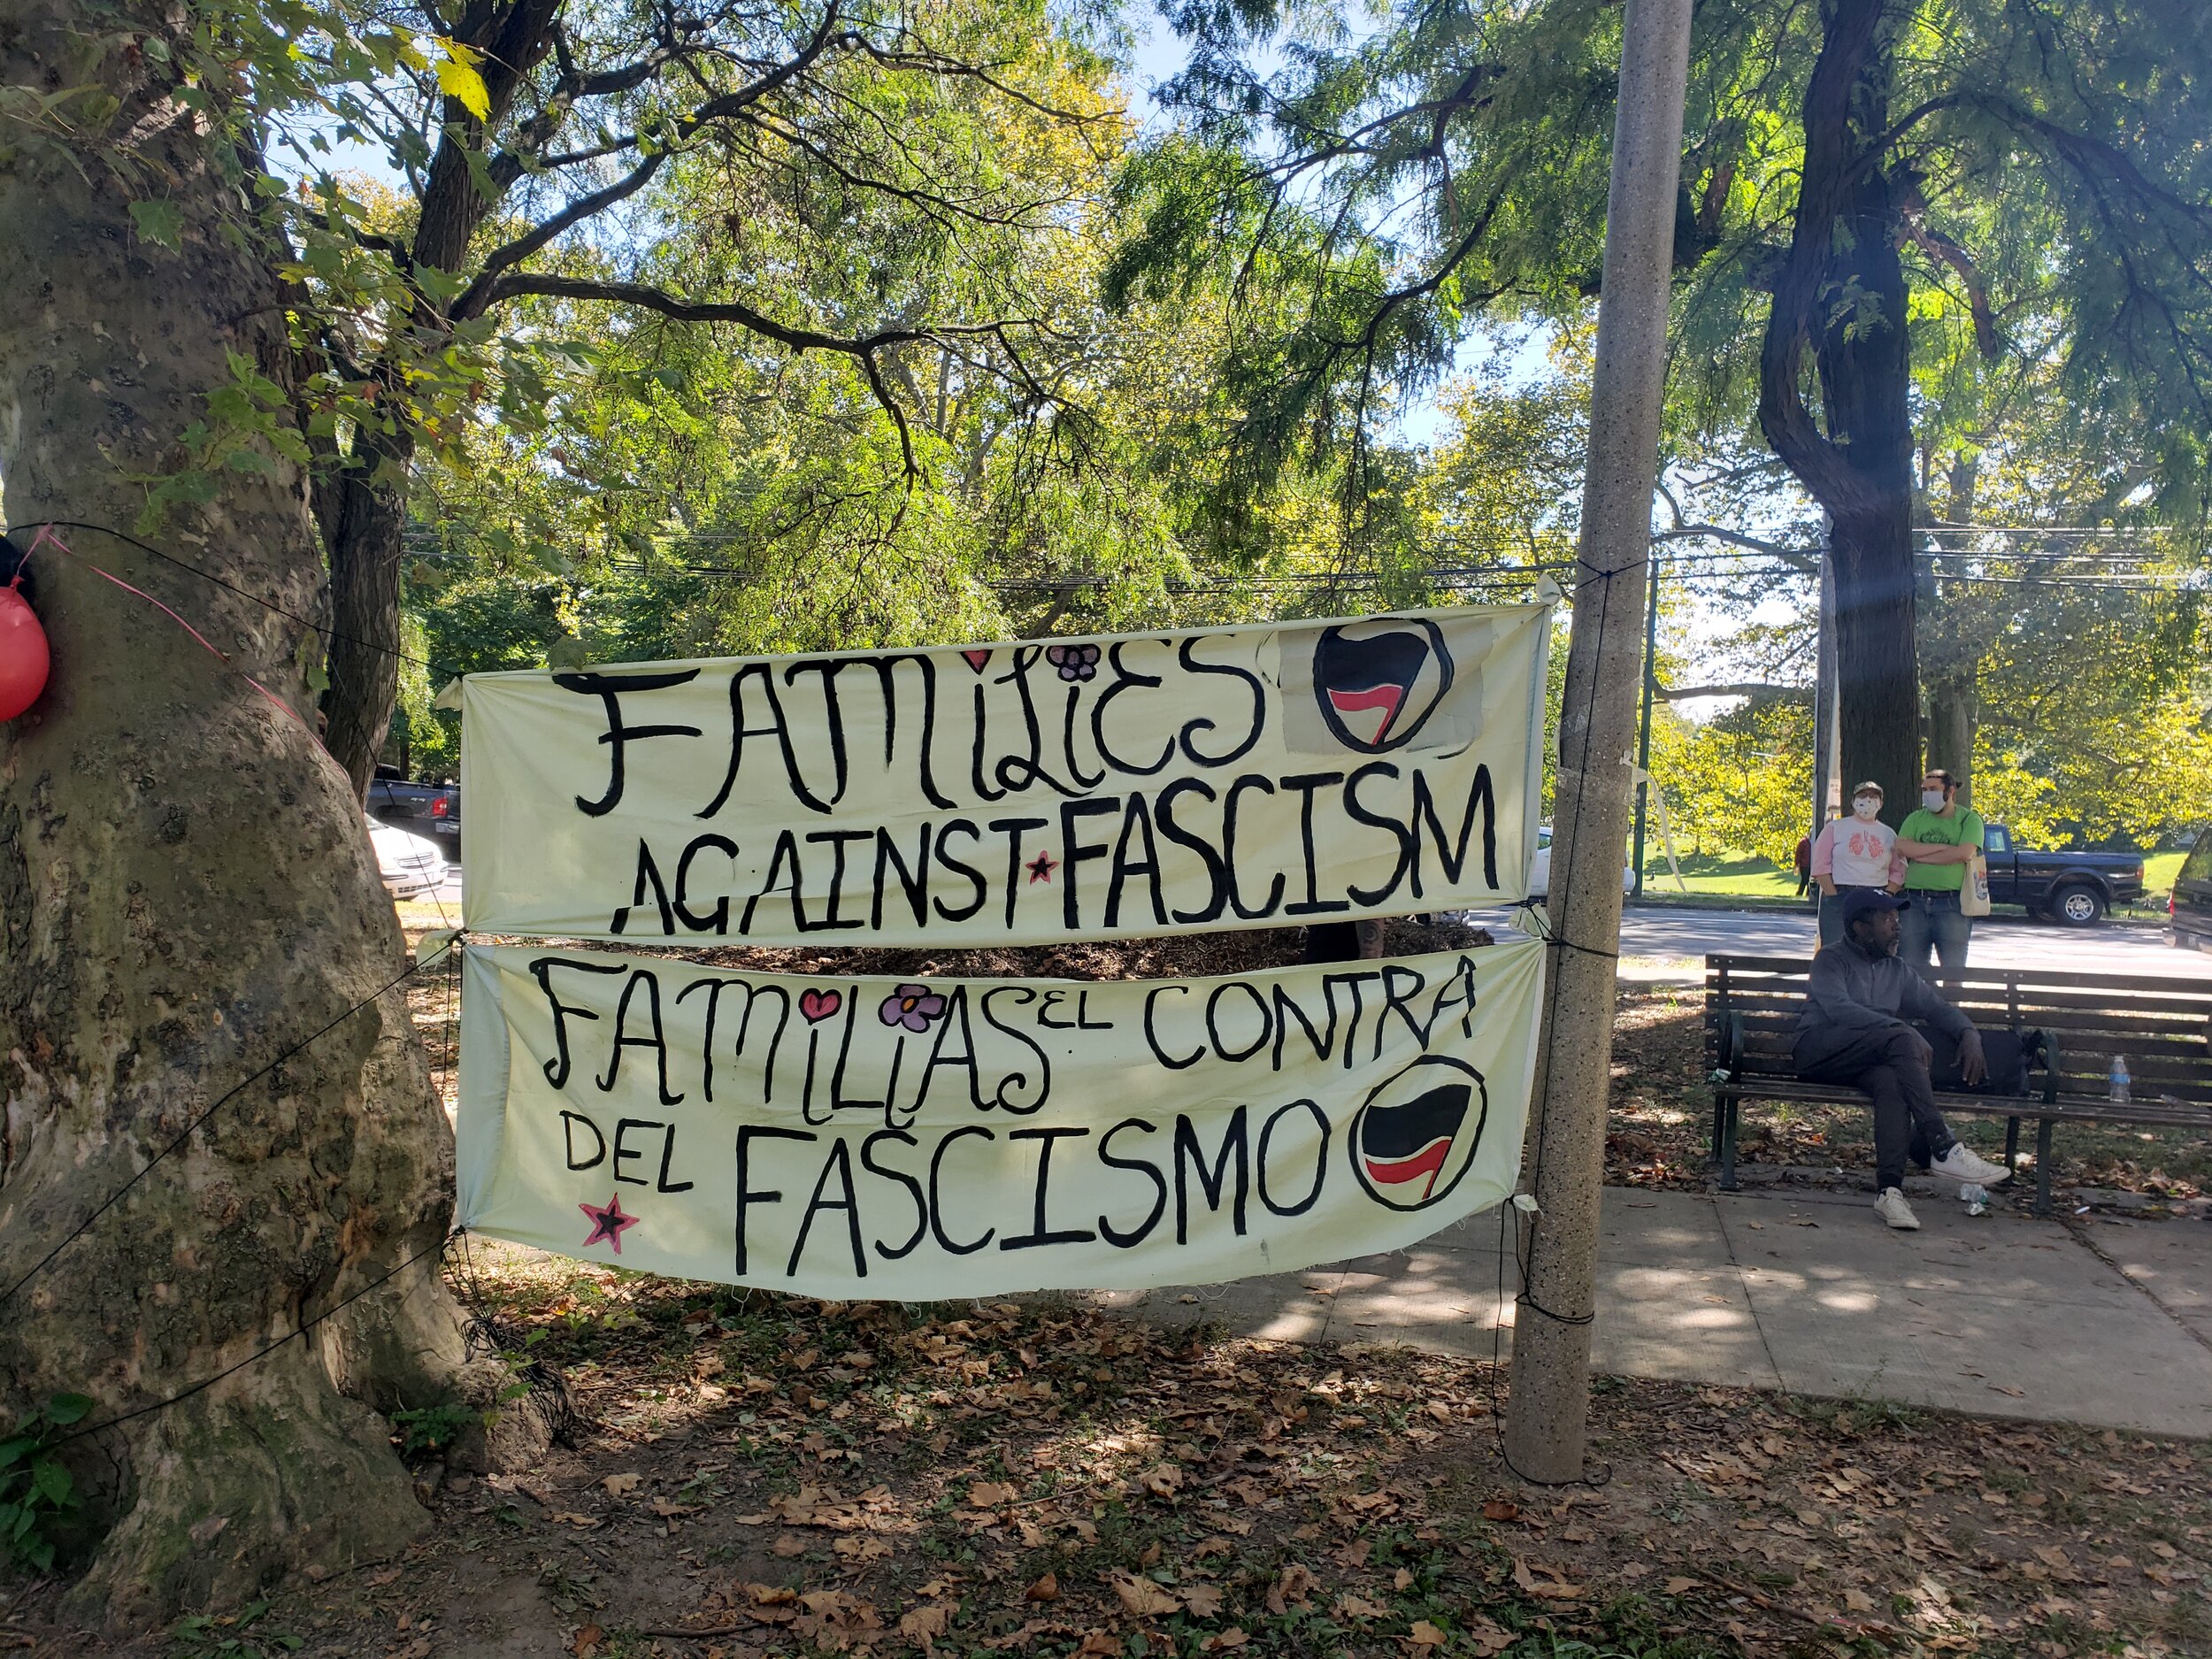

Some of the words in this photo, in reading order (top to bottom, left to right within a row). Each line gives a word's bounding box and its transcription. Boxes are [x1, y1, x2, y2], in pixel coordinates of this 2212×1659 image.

[610, 817, 1048, 935] AGAINST
[1060, 762, 1499, 929] FASCISM
[1037, 989, 1114, 1030] EL
[1144, 954, 1477, 1071] CONTRA
[559, 1110, 694, 1194] DEL
[735, 1098, 1332, 1278] FASCISMO
